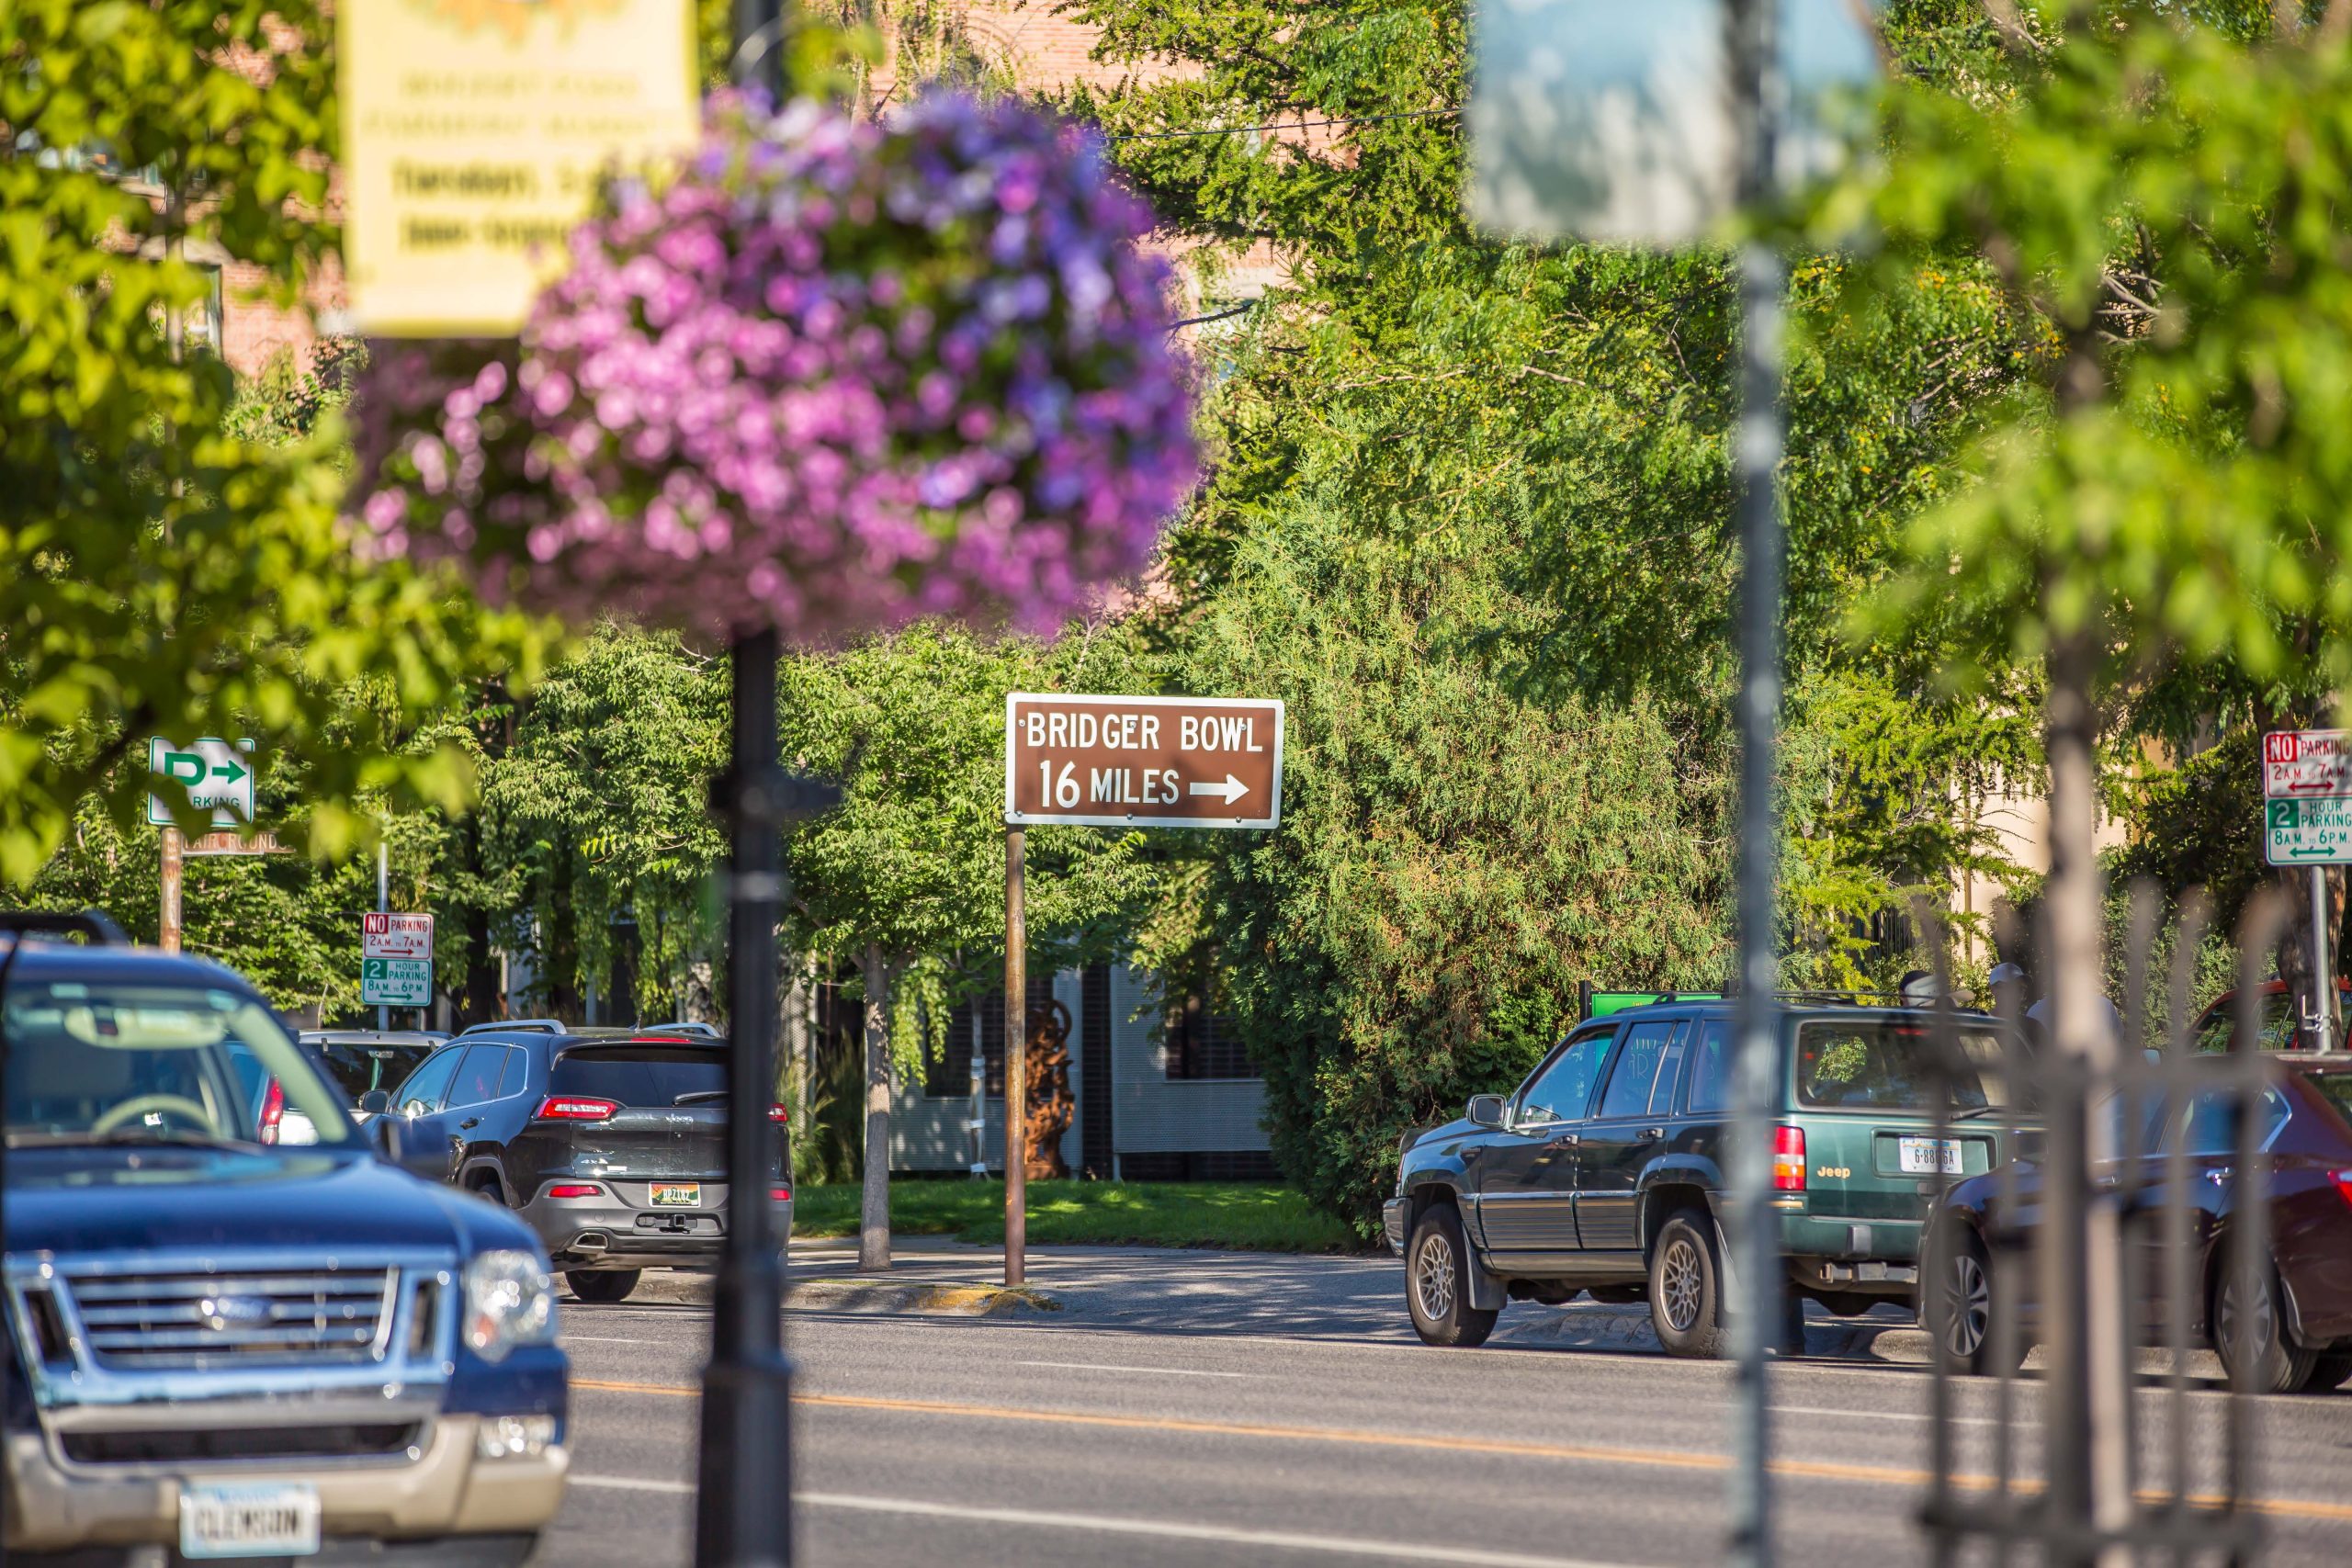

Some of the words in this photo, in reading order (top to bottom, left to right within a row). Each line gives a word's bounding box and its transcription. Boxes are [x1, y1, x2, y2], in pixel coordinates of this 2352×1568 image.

[1027, 712, 1160, 750] BRIDGER
[1181, 716, 1263, 752] BOWL
[2270, 736, 2293, 761] NO
[2301, 739, 2350, 757] PARKING
[1039, 760, 1080, 808] 16
[1091, 768, 1180, 806] MILES
[163, 795, 241, 809] RKING
[2275, 801, 2290, 826] 2
[2310, 801, 2343, 813] HOUR
[2301, 814, 2352, 828] PARKING
[368, 916, 385, 932] NO
[390, 919, 428, 933] PARKING
[369, 961, 381, 978] 2
[395, 963, 420, 971] HOUR
[389, 970, 427, 981] PARKING
[1816, 1166, 1851, 1179] Jeep
[195, 1508, 299, 1540] CLEMSON
